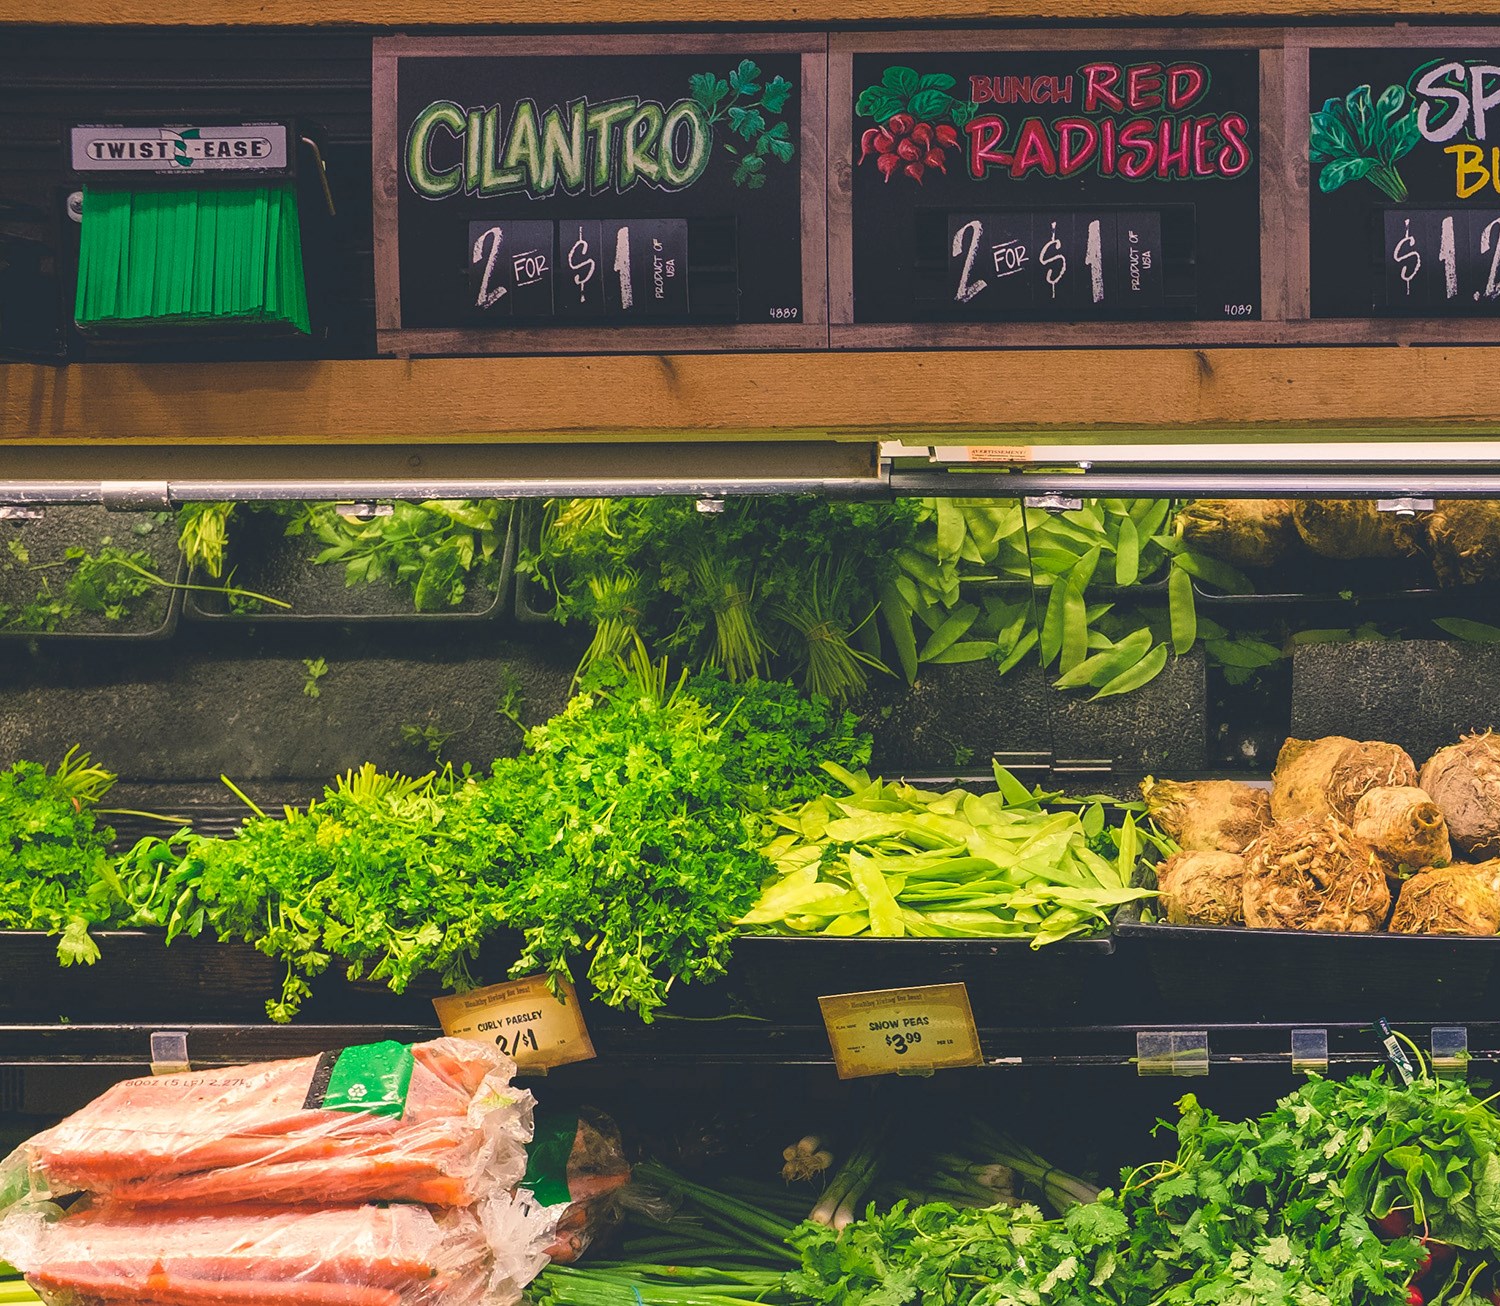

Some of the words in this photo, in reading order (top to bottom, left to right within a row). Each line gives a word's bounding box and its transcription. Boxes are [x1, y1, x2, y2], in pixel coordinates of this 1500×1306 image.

[969, 75, 1072, 103] BUNCH
[1080, 63, 1208, 113] RED
[92, 141, 168, 158] TWIST
[406, 97, 711, 199] CILANTRO
[965, 114, 1253, 180] RADISHES
[653, 238, 664, 252] OF
[1128, 230, 1139, 244] OF
[472, 226, 508, 309] 2
[512, 252, 549, 284] FOR
[666, 258, 676, 278] USA
[952, 220, 988, 303] 2
[993, 242, 1029, 275] FOR
[1129, 247, 1141, 291] PRODUCT
[1142, 250, 1152, 270] USA
[654, 254, 665, 299] PRODUCT
[769, 307, 798, 319] 4889
[1224, 304, 1253, 316] 4089
[488, 992, 506, 1003] living
[506, 989, 516, 997] for
[477, 1019, 503, 1033] CURLY
[506, 1010, 543, 1026] PARSLEY
[869, 1020, 900, 1032] SNOW
[902, 1016, 930, 1028] PEAS
[495, 1028, 539, 1056] 2/$1
